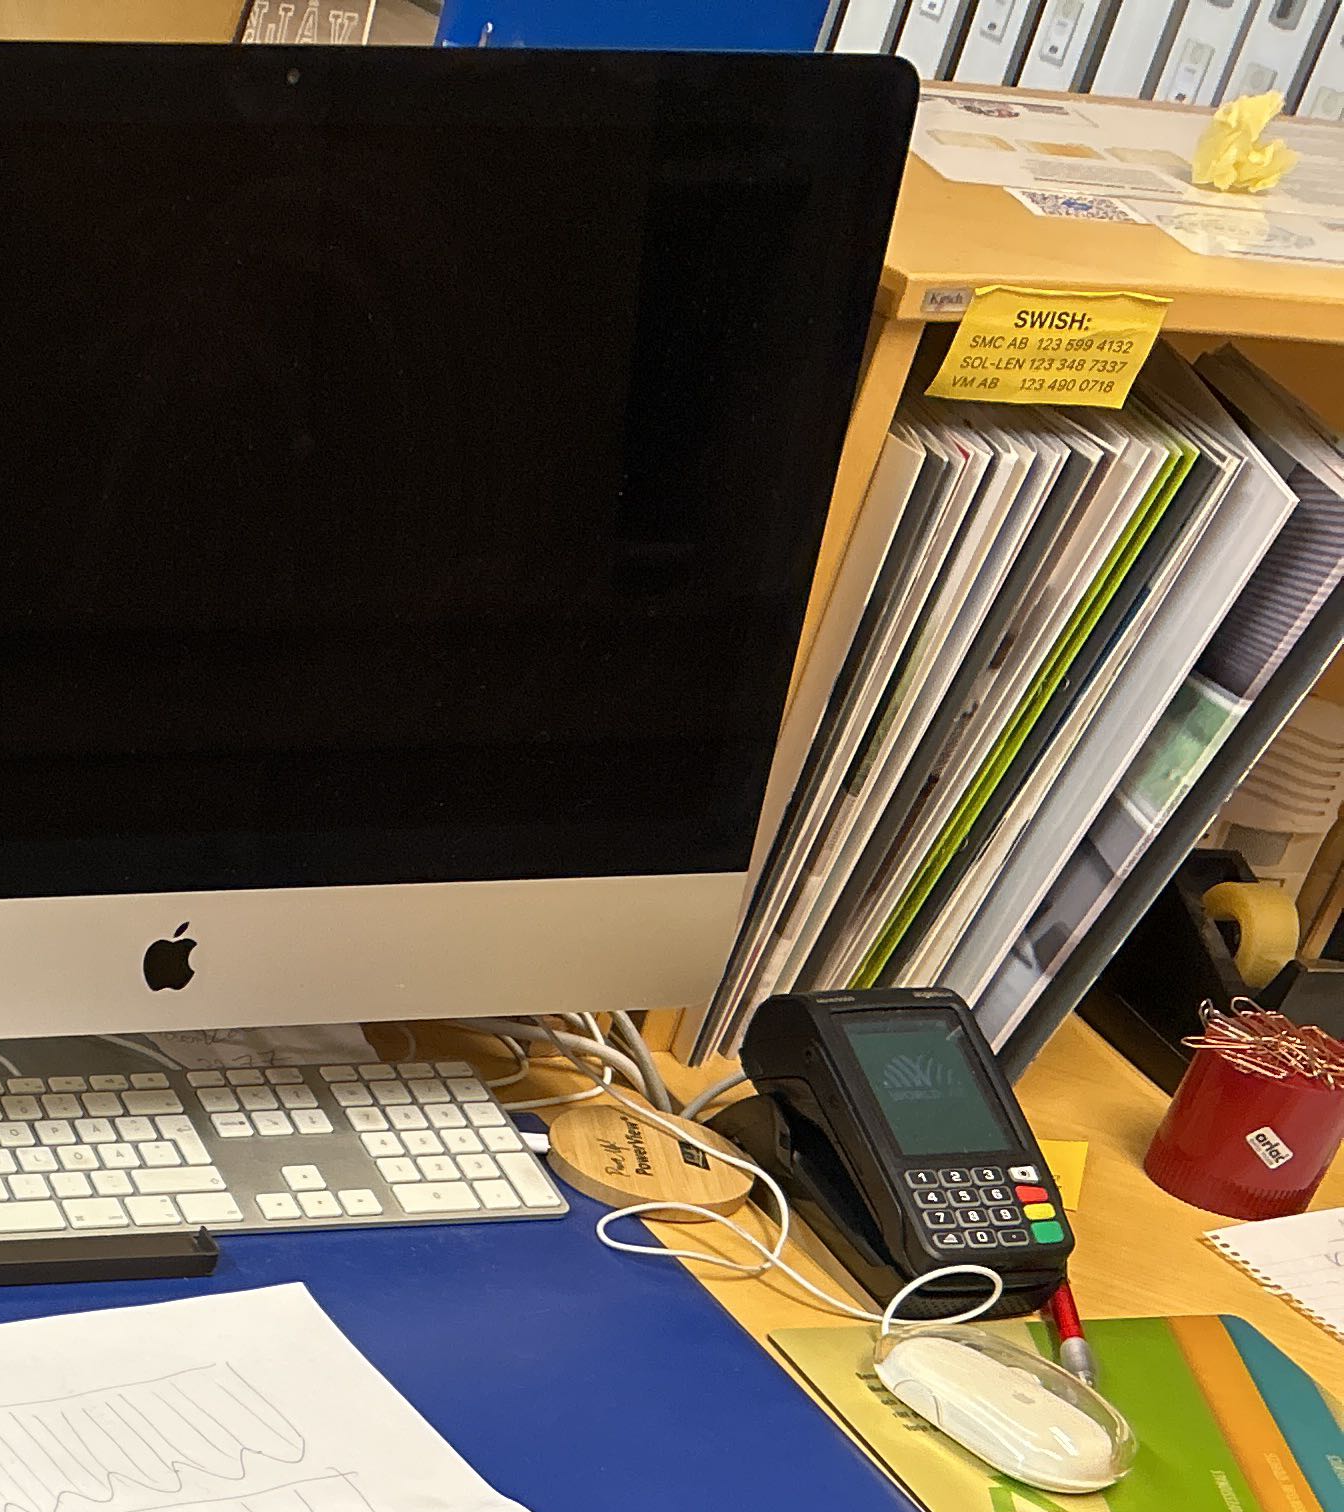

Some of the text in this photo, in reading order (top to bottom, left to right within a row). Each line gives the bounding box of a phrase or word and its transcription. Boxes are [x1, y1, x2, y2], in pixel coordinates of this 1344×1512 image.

[1014, 310, 1092, 331] SWISH:
[970, 335, 1004, 349] SMC
[1007, 337, 1029, 349] AB
[1036, 338, 1061, 350] 123
[1096, 339, 1133, 354] 4132
[960, 356, 1127, 374] SOL-LEN 123 348 7337
[952, 376, 1114, 392] VM AB 123 490 0718
[918, 1172, 928, 1183] 1
[950, 1171, 962, 1182] 2
[983, 1170, 995, 1180] 3
[927, 1192, 938, 1202] 4
[959, 1191, 970, 1201] 5
[992, 1189, 1003, 1199] 6
[934, 1212, 945, 1223] 7
[968, 1210, 980, 1221] 8
[1000, 1209, 1011, 1220] 9
[977, 1231, 988, 1242] 0
